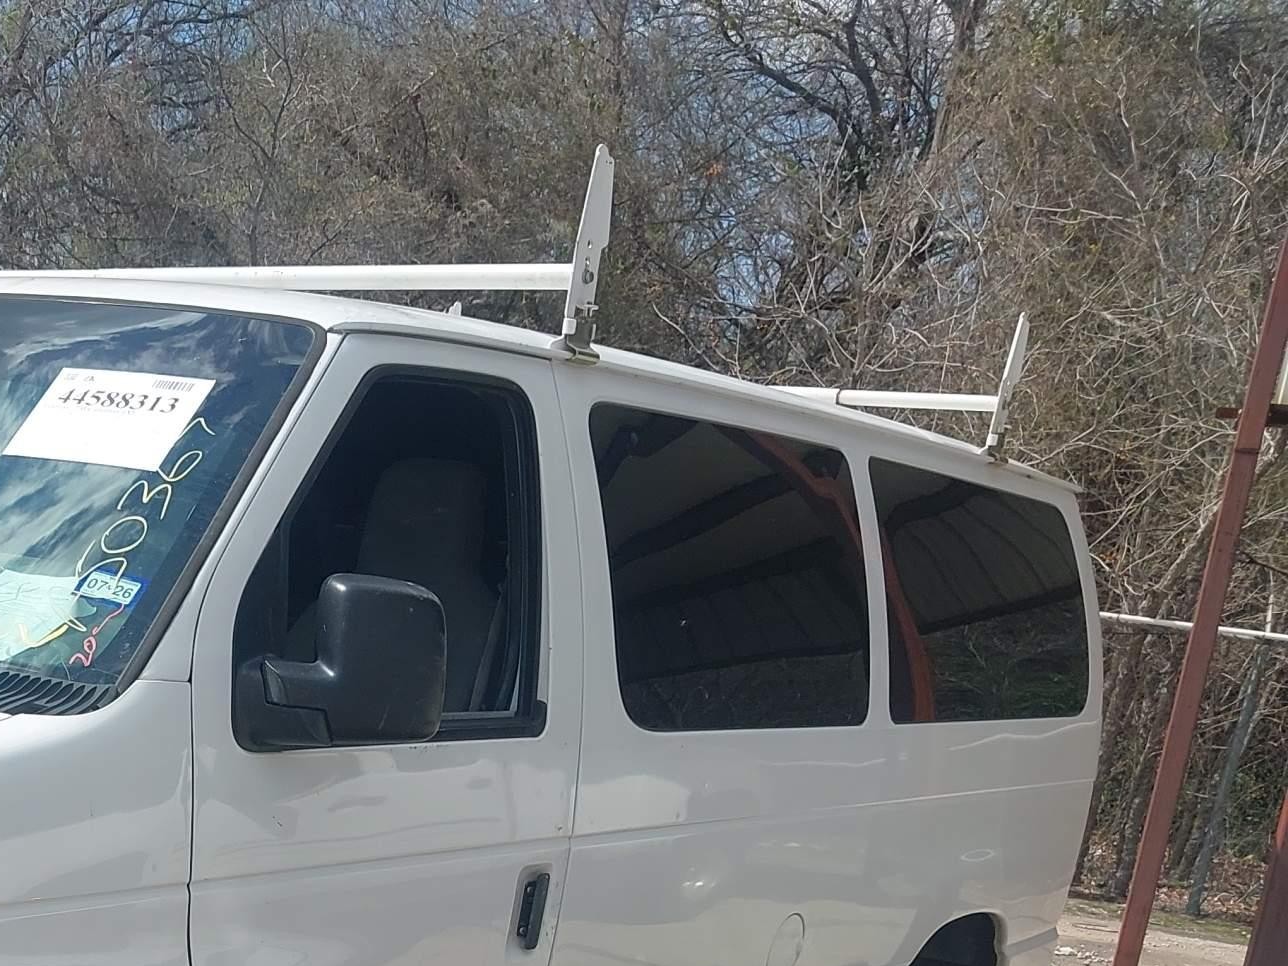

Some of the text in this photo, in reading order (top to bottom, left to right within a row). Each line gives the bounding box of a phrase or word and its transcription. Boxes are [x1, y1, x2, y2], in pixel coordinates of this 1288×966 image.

[58, 388, 180, 414] 44588313
[86, 577, 135, 600] 07 26
